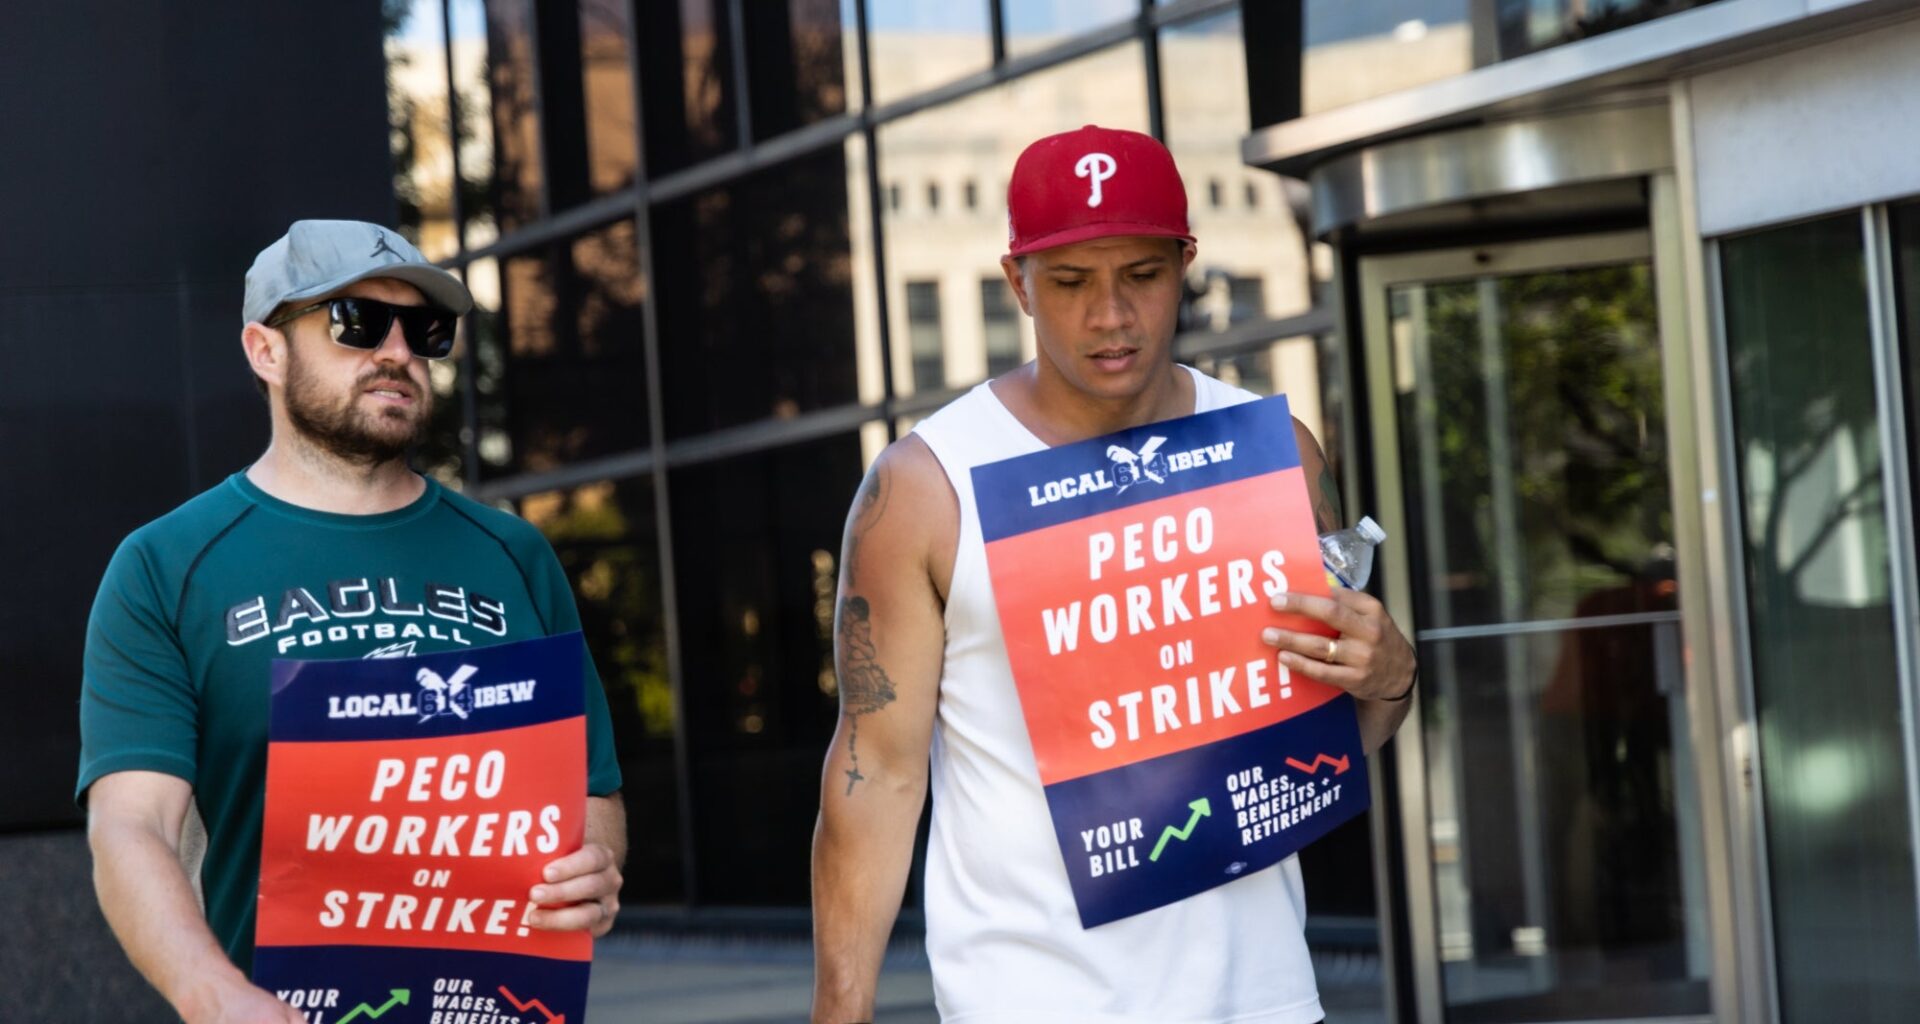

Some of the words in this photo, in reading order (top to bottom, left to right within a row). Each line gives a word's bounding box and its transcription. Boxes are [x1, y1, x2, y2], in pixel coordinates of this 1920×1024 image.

[1075, 152, 1117, 208] P
[1028, 470, 1113, 507] LOCAL
[1167, 441, 1235, 472] IBEW
[1088, 507, 1214, 581] PECO
[225, 577, 507, 646] EAGLES
[1042, 550, 1288, 656] WORKERS
[277, 623, 471, 654] FOOTBALL
[1160, 639, 1194, 670] ON
[328, 693, 418, 718] LOCAL
[474, 679, 536, 708] IBEW
[1088, 659, 1292, 749] STRIKE!
[370, 750, 505, 802] PECO
[1226, 766, 1263, 792] OUR
[1231, 775, 1295, 810] WAGES,
[1237, 782, 1315, 828] BENEFITS
[1242, 784, 1341, 846] RETIREMENT
[305, 804, 561, 857] WORKERS
[1081, 817, 1144, 852] YOUR
[413, 869, 451, 888] ON
[1089, 845, 1139, 877] BILL
[319, 890, 538, 937] STRIKE!
[432, 995, 500, 1014] WAGES,
[433, 978, 473, 994] OUR
